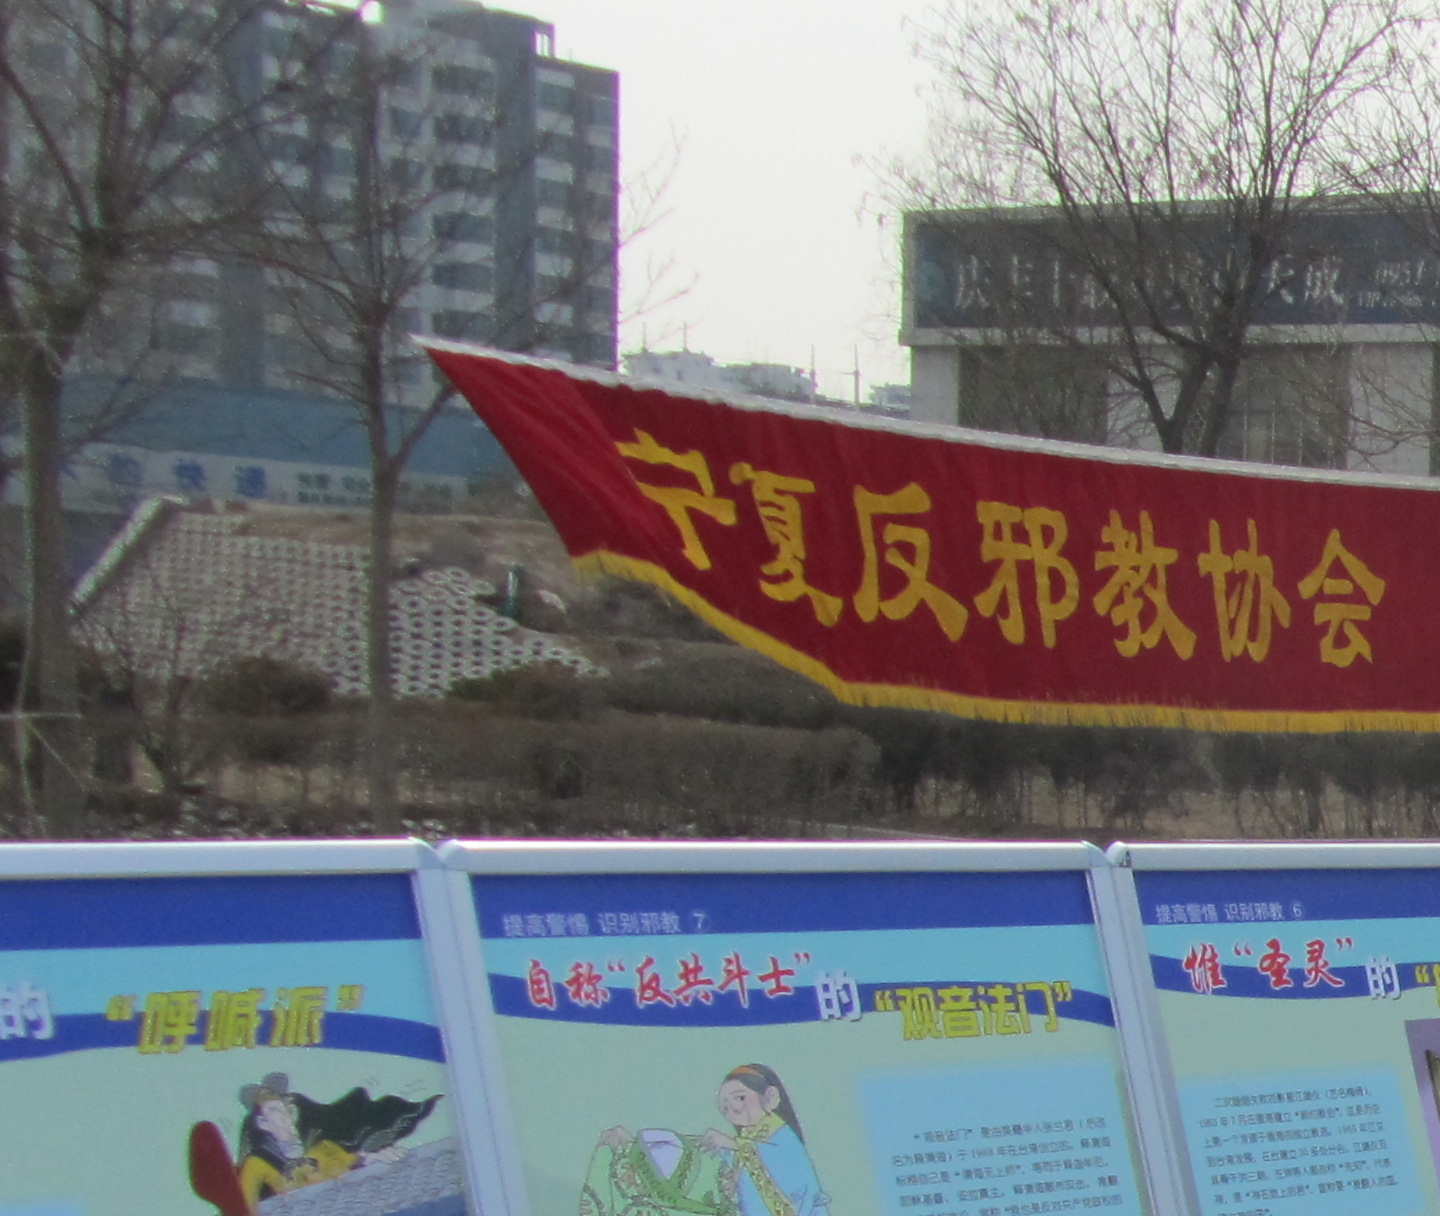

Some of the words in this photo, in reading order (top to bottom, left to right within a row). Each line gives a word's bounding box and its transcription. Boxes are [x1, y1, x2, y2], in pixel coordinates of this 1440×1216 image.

[615, 428, 1386, 668] 宁夏反邪教协会
[503, 912, 589, 938] 提高警惕
[597, 910, 682, 935] 识别邪教
[1224, 901, 1285, 921] 识别邪教
